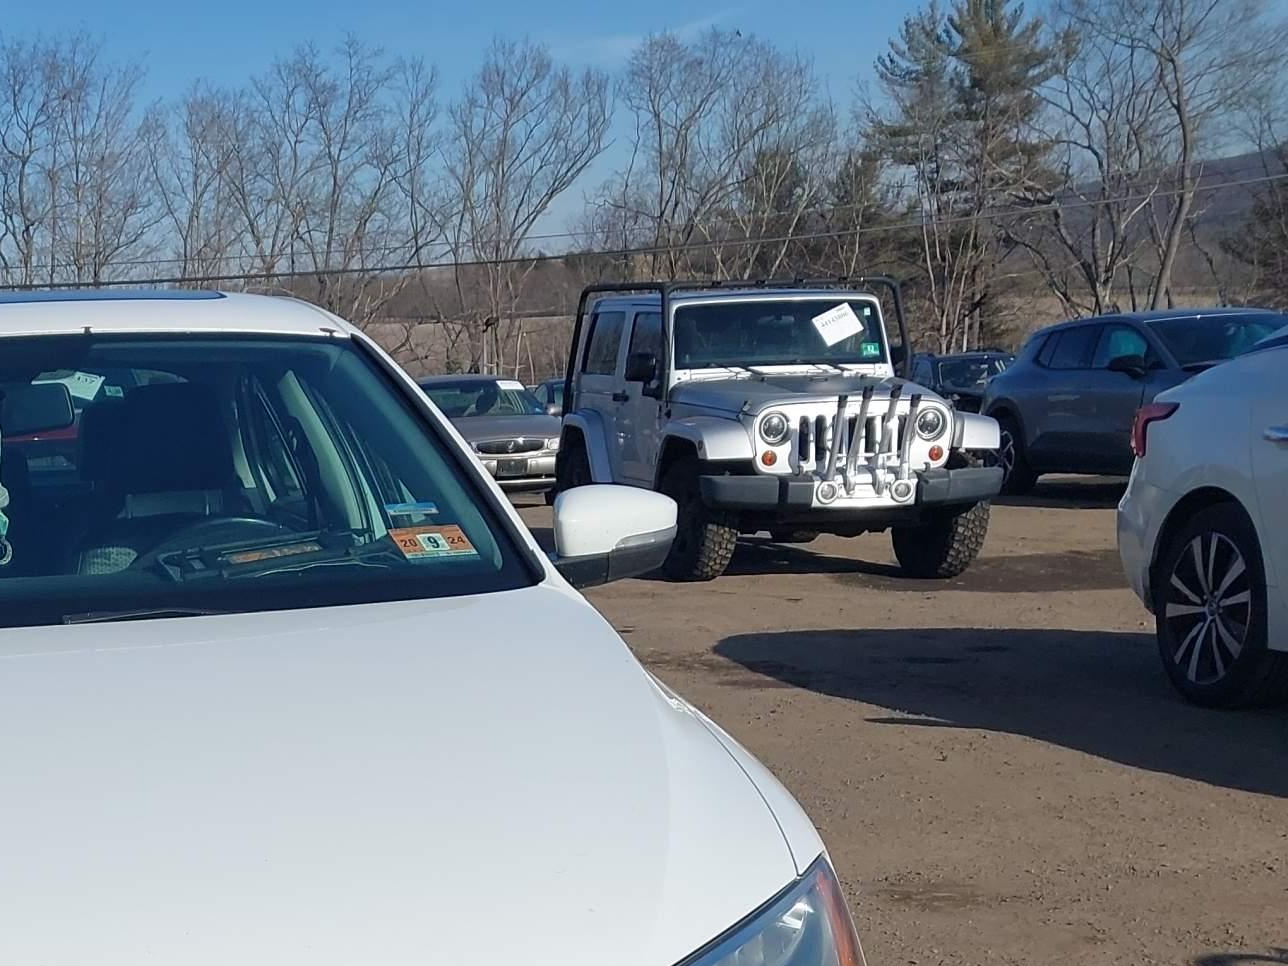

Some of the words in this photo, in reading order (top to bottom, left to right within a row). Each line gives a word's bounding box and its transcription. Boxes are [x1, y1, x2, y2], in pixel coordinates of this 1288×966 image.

[400, 538, 418, 548] 20
[427, 536, 440, 549] 9
[447, 535, 466, 545] 24
